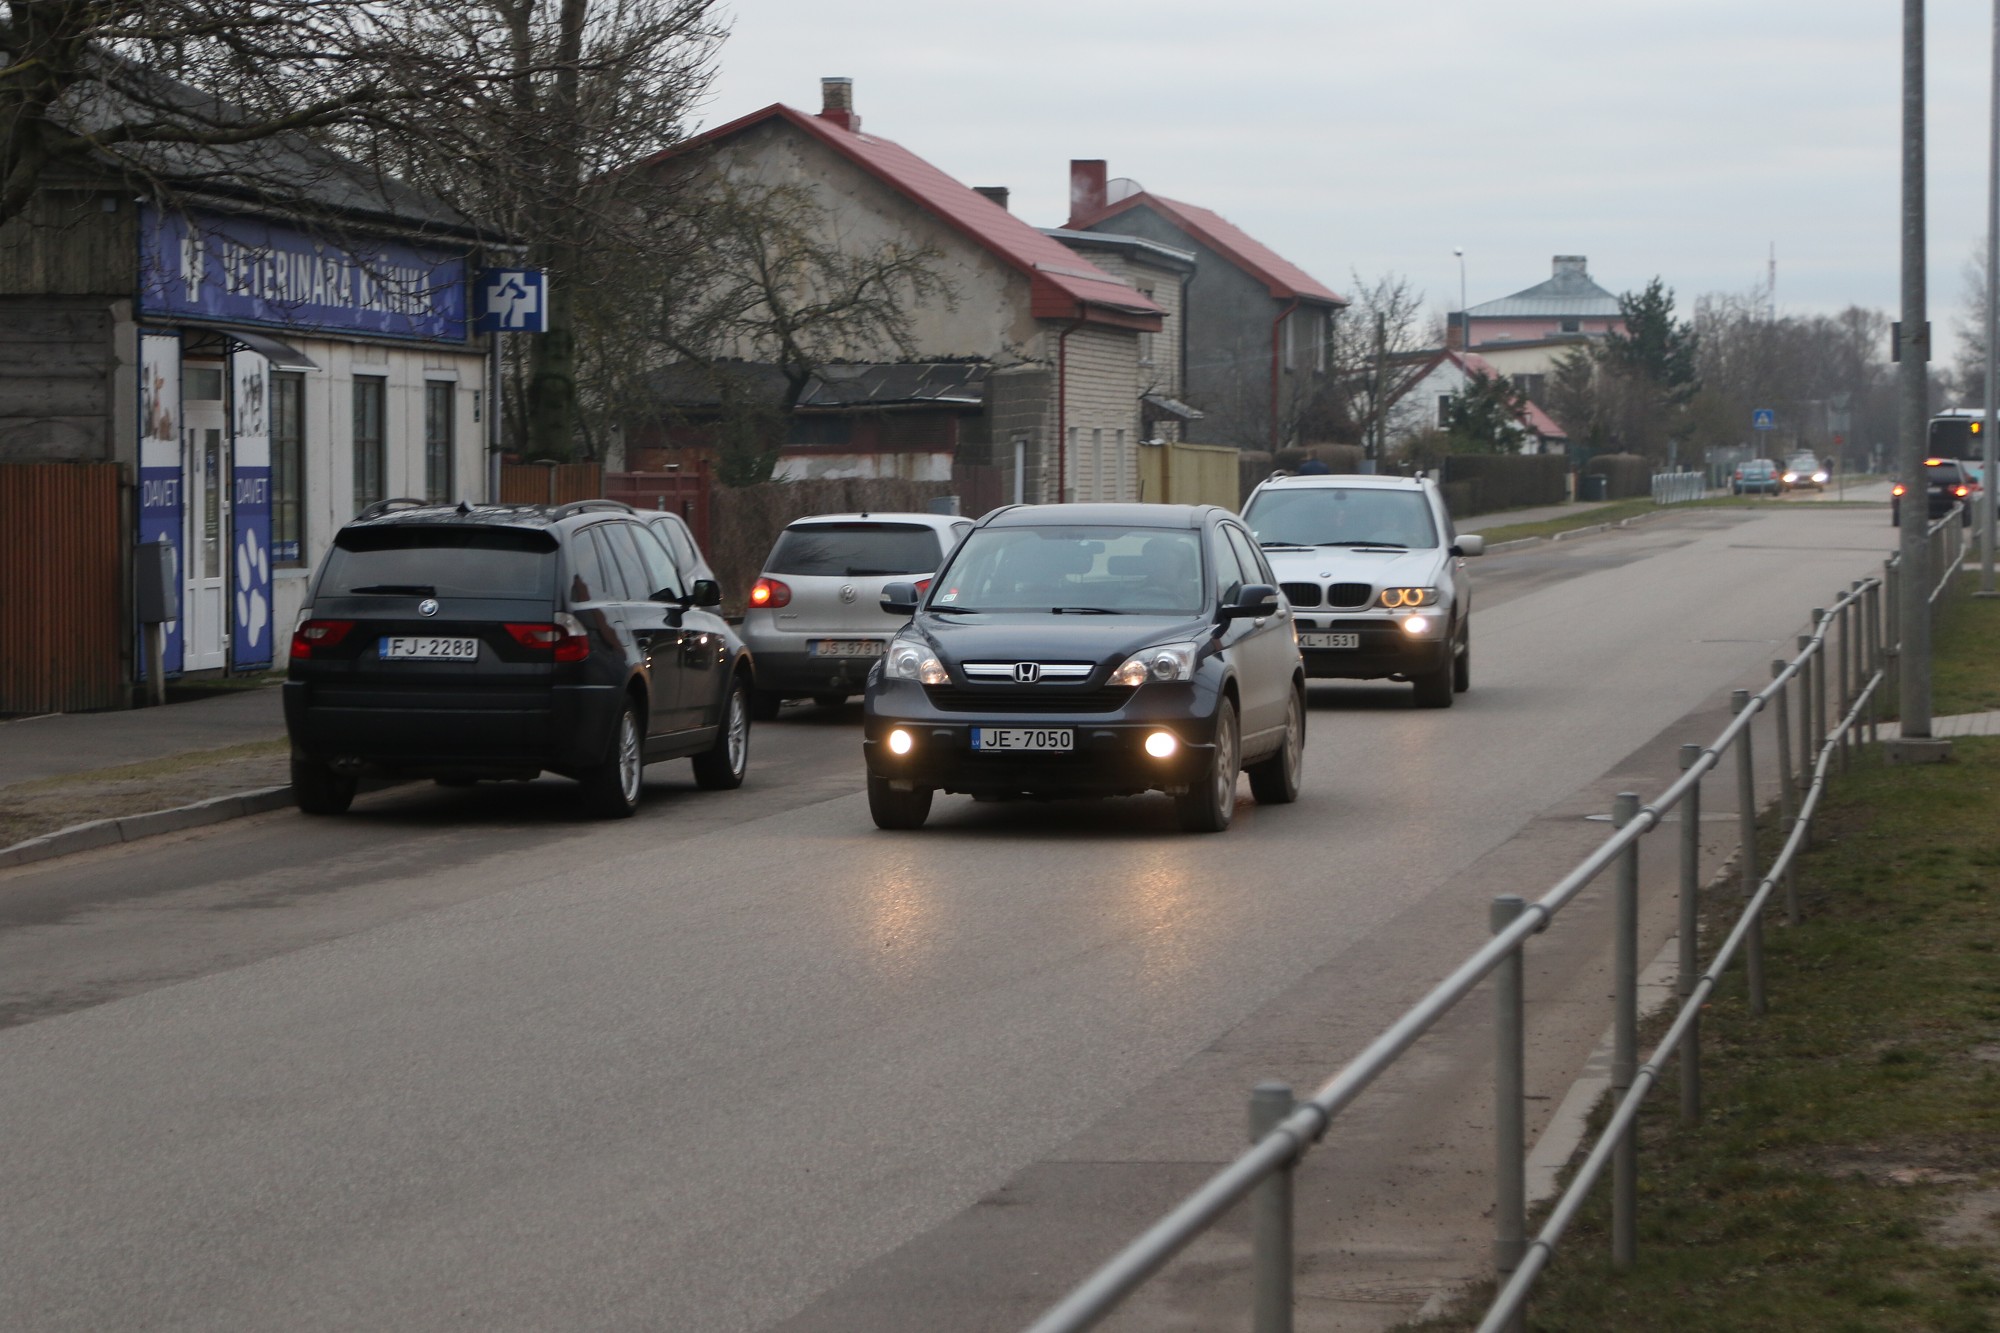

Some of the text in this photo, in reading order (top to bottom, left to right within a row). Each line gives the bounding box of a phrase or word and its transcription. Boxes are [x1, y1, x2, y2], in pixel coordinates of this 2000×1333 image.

[142, 479, 179, 507] DAVET
[236, 477, 268, 505] DAVET
[391, 638, 475, 657] FJ-2288
[985, 730, 1071, 748] JE-7050
